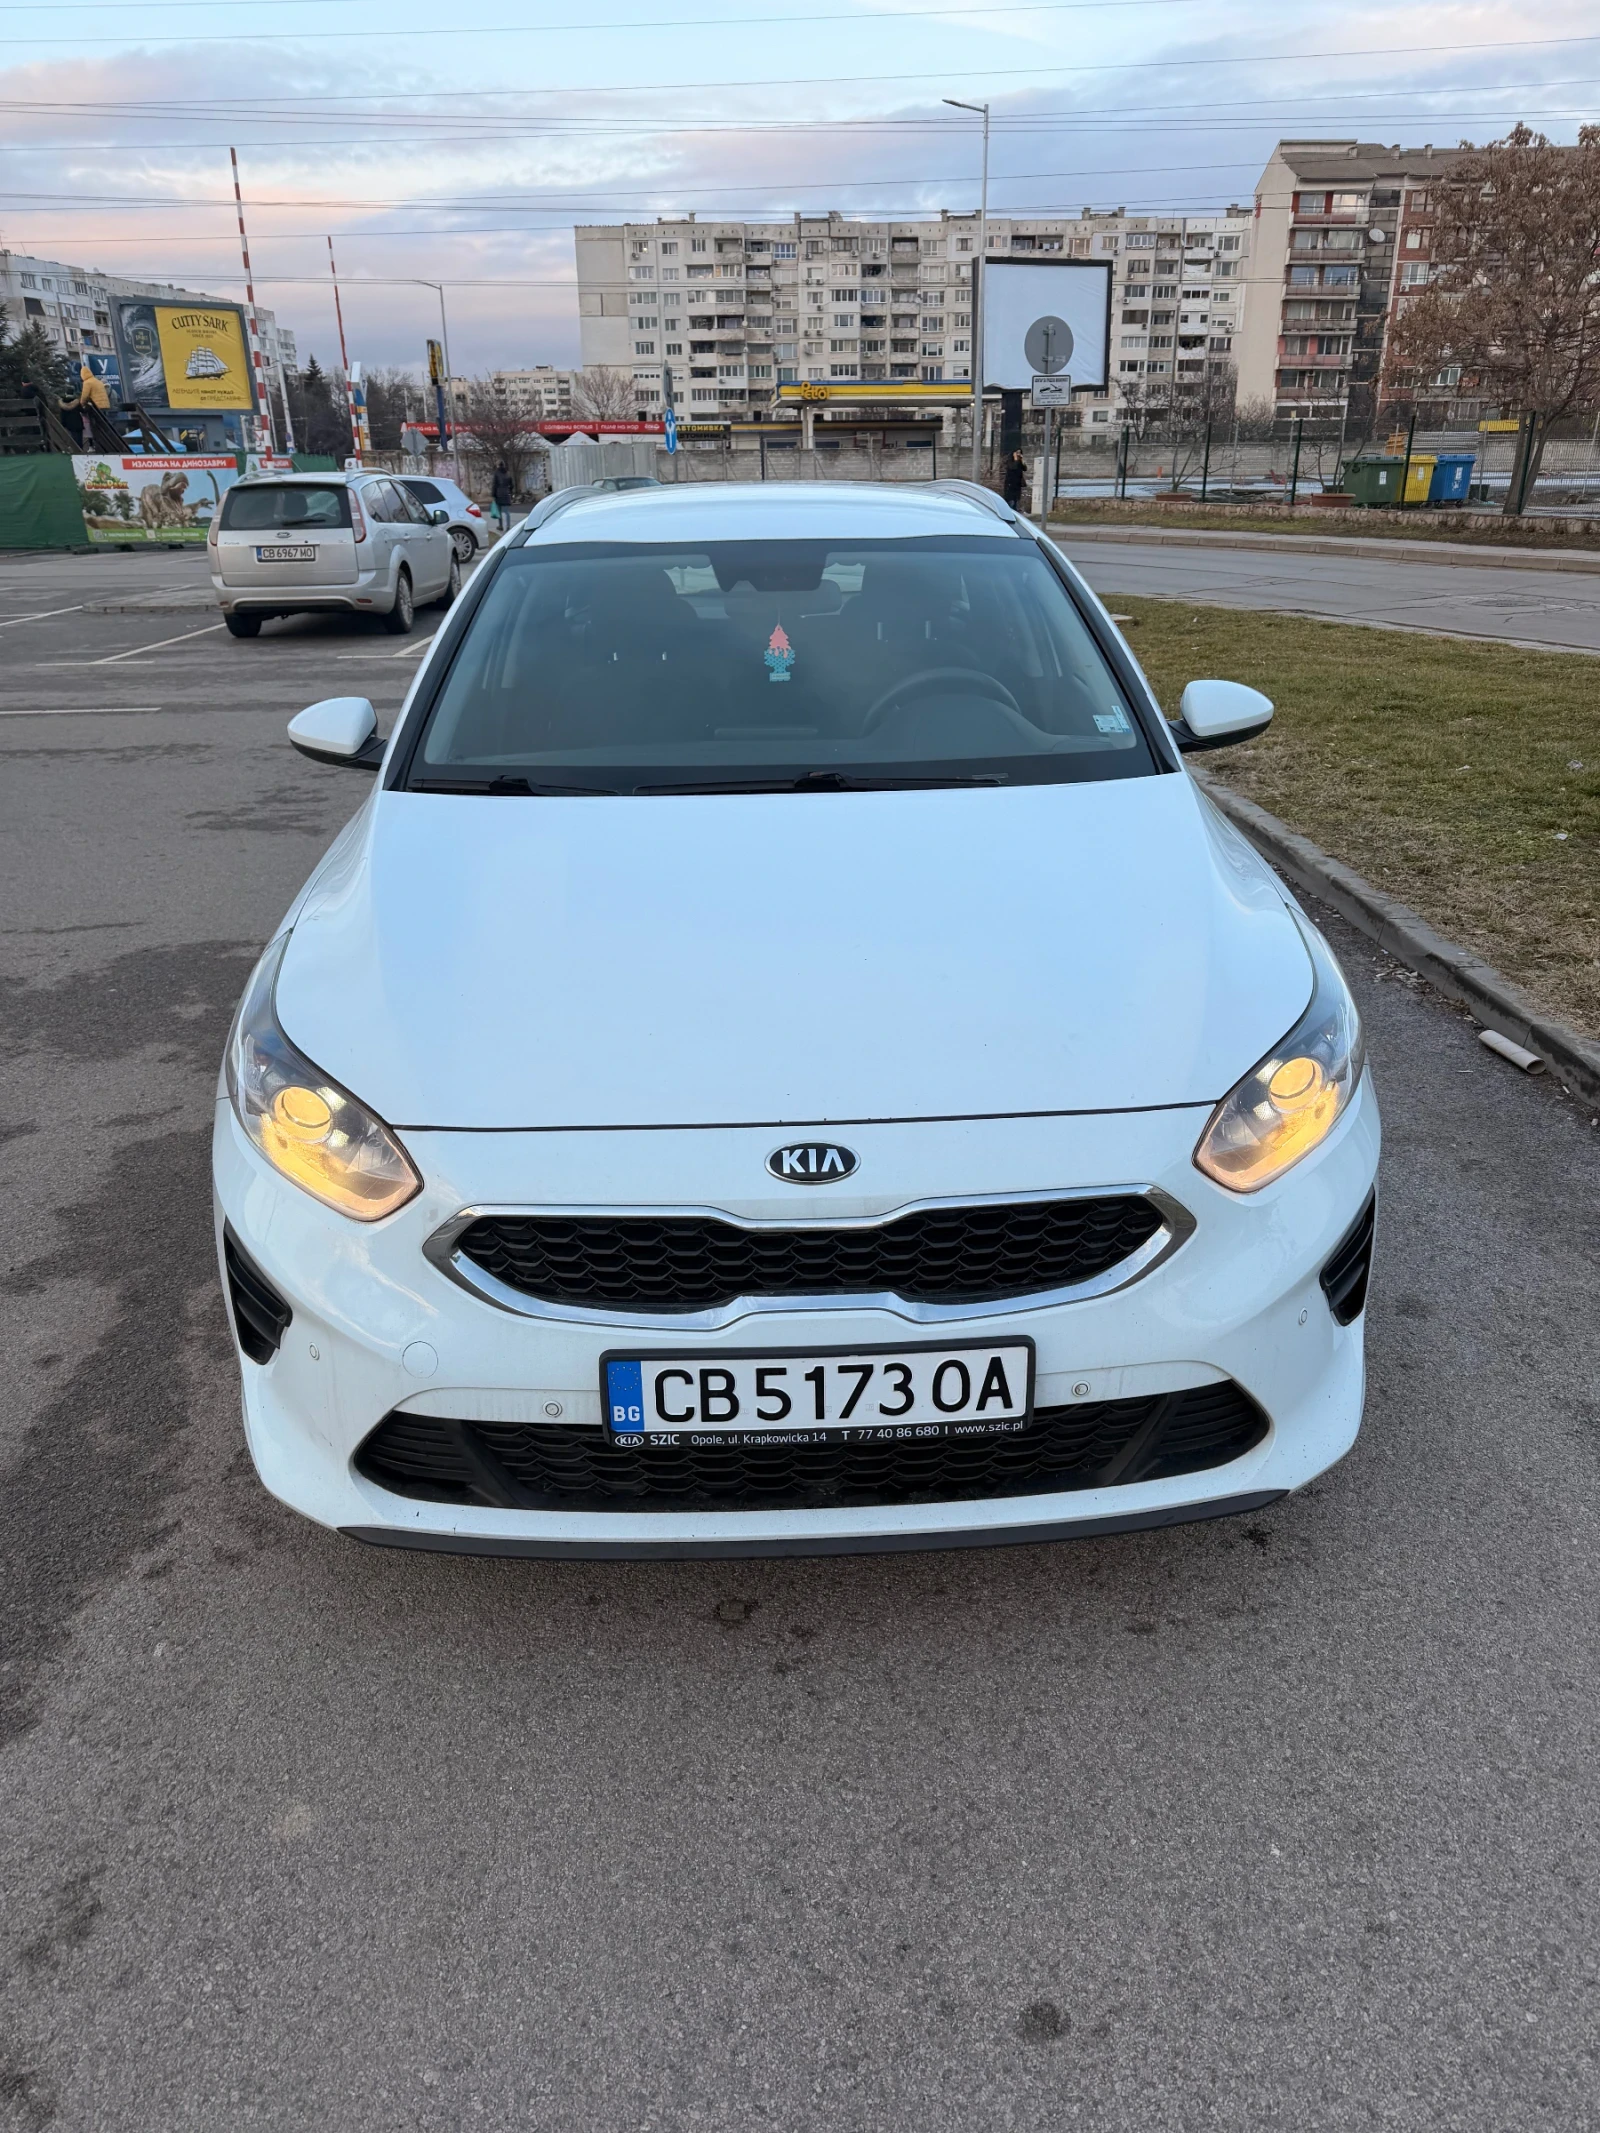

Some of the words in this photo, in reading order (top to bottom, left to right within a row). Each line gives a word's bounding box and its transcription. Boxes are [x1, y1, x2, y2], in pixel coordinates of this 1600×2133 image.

[171, 314, 202, 330] CUTTY
[202, 315, 229, 333] SARK
[131, 460, 170, 468] ИЗЛОЖБА
[170, 460, 180, 468] НА
[181, 459, 227, 468] ДИНОЗАВРИ
[263, 549, 275, 558] CB
[277, 548, 298, 558] 6967
[781, 1148, 845, 1174] KIA
[655, 1368, 740, 1422] CB
[755, 1363, 915, 1421] 5173
[613, 1405, 640, 1422] BG
[620, 1437, 640, 1445] KIA
[650, 1434, 680, 1445] SZIC
[691, 1434, 725, 1446] Opole,
[728, 1434, 741, 1444] ul.
[743, 1432, 809, 1445] Krapkowicka
[812, 1432, 827, 1441] 14
[841, 1430, 850, 1440] T
[857, 1429, 873, 1439] 77
[876, 1428, 893, 1438] 40
[896, 1427, 912, 1437] 86
[915, 1425, 940, 1436] 680
[954, 1420, 1023, 1434] www.szic.pl
